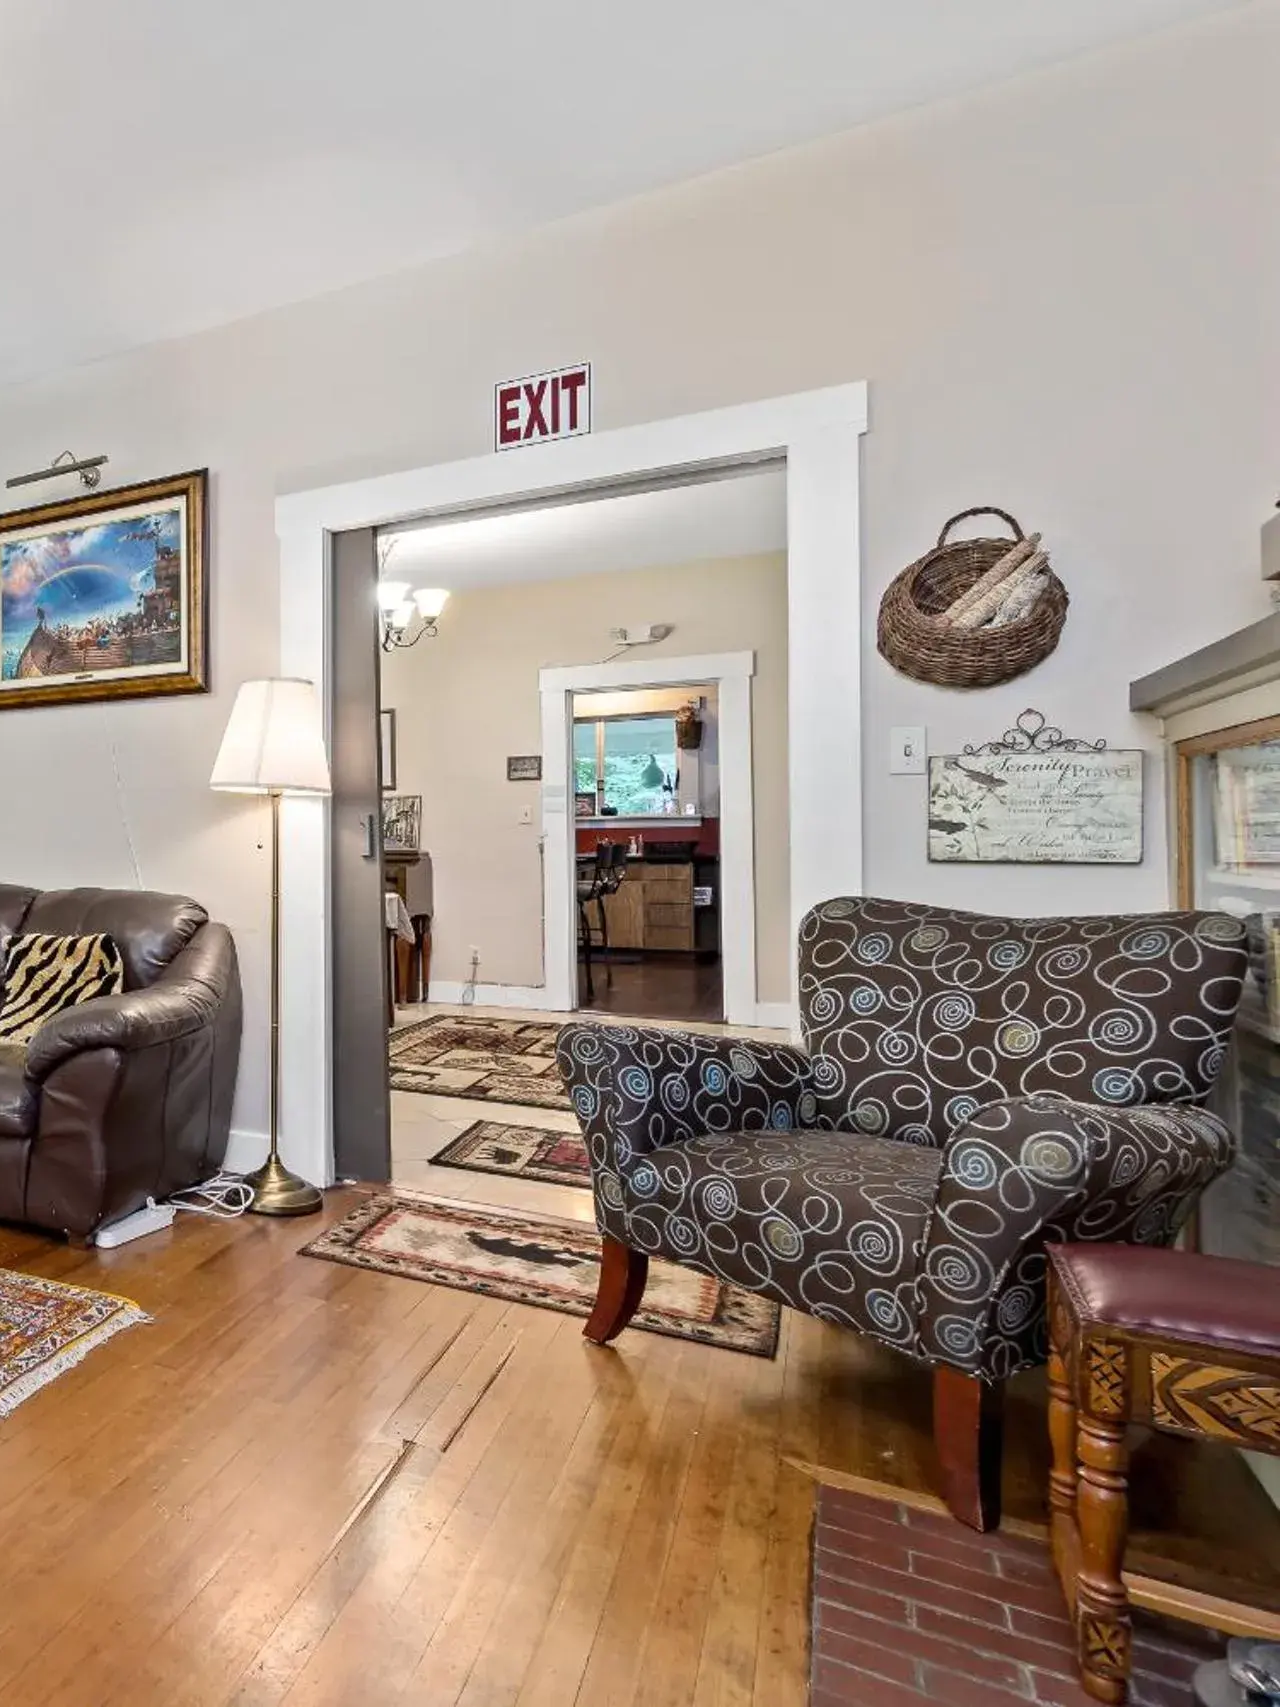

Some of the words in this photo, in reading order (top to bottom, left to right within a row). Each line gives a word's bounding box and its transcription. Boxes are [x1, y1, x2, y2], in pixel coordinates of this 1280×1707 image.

[500, 371, 586, 444] EXIT
[994, 757, 1071, 784] Serenity
[1072, 763, 1132, 778] Prayer
